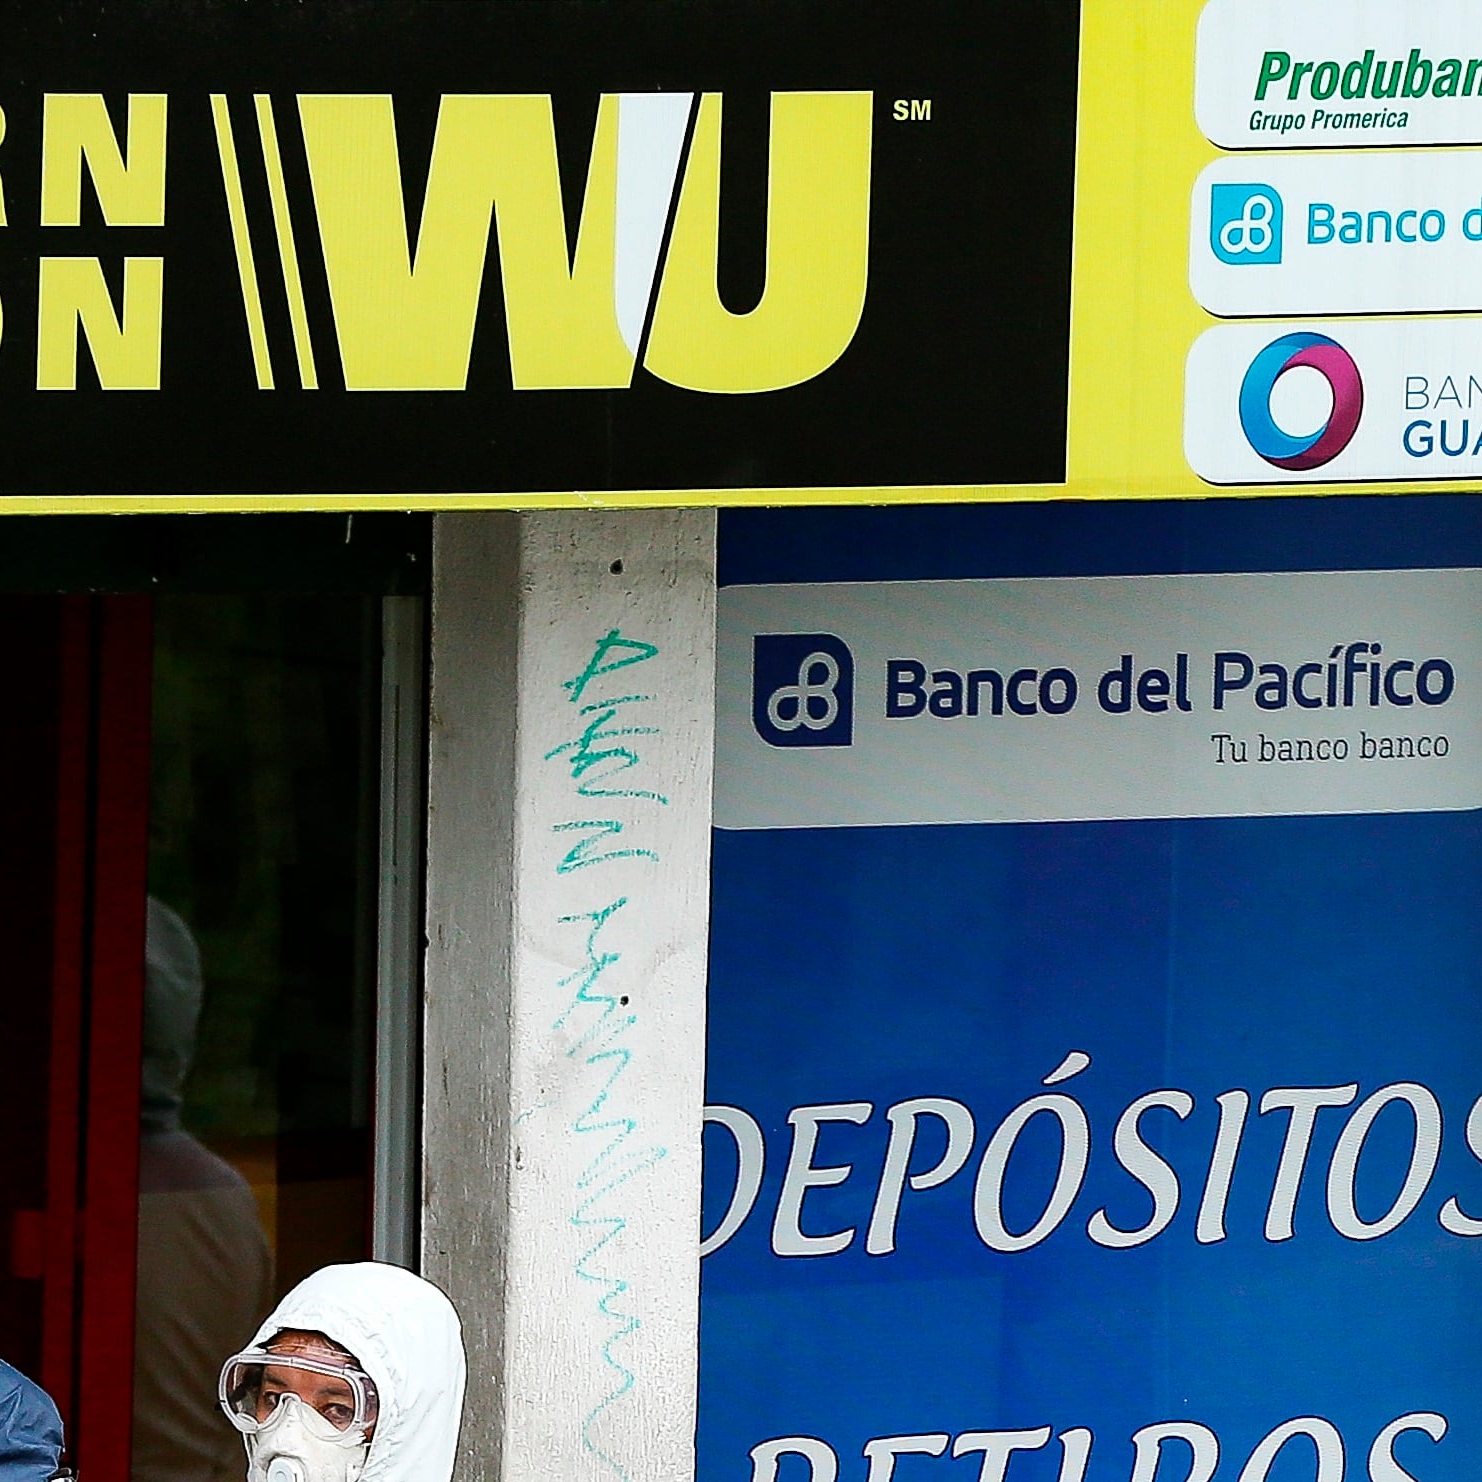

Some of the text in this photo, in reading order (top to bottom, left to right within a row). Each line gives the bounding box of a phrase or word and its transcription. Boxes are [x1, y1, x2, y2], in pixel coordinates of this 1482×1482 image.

[1249, 107, 1409, 134] Grupo Promerica
[296, 90, 932, 394] WU SM
[1306, 202, 1445, 245] Banco
[885, 642, 1455, 718] Banco del Pacífico
[1211, 729, 1450, 765] Tu banco banco
